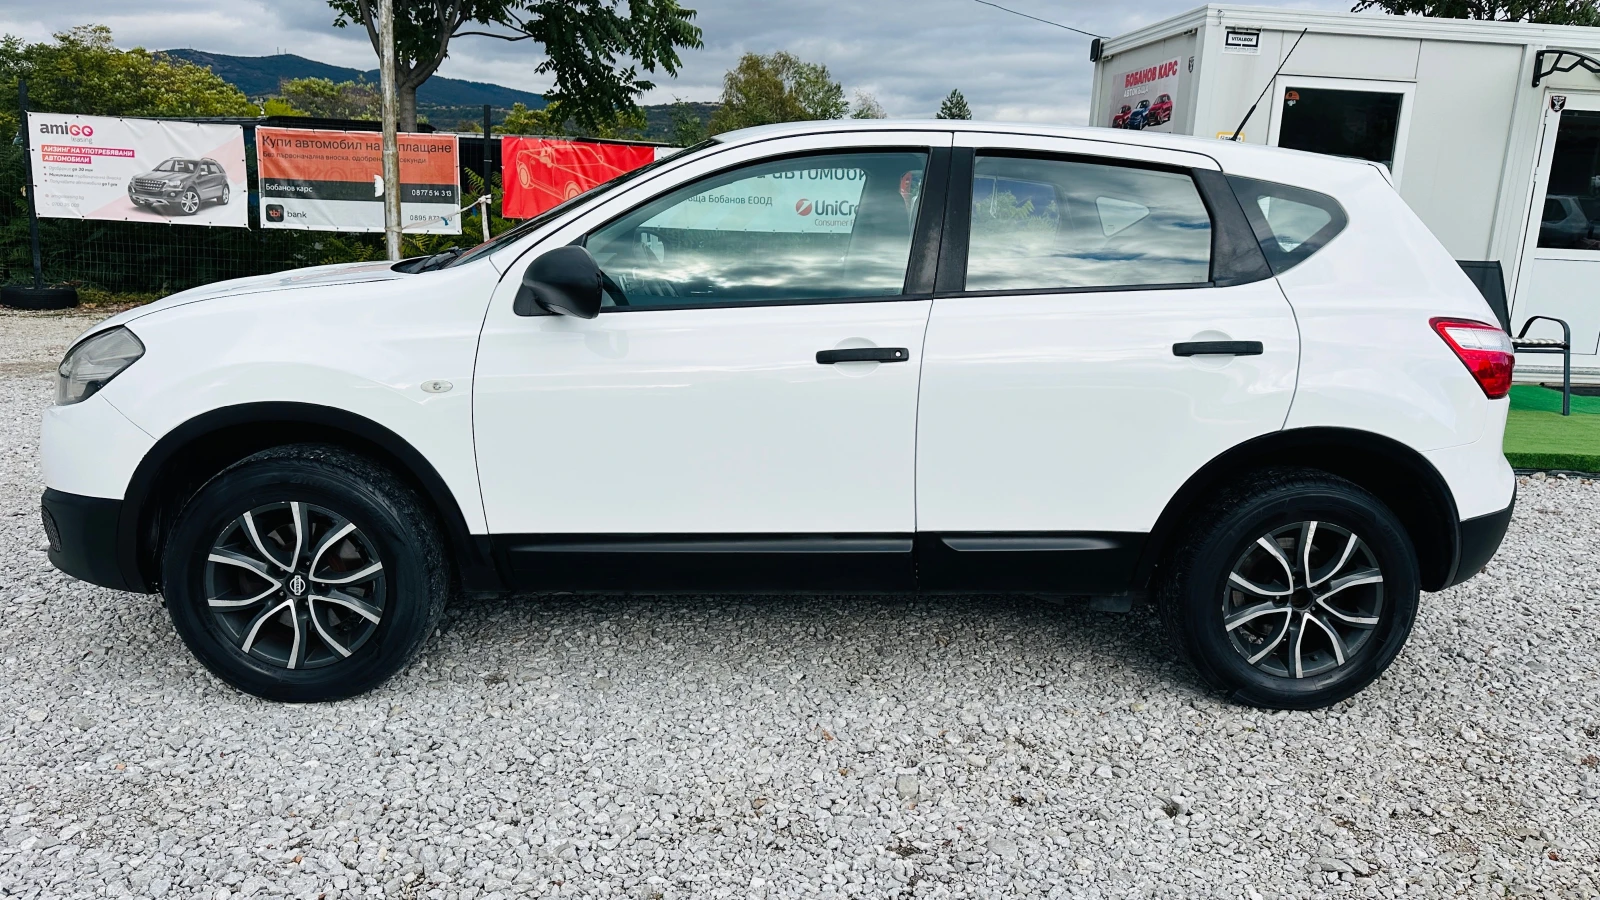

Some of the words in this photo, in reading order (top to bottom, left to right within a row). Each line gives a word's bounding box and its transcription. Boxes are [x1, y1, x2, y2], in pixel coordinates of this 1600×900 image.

[1124, 66, 1157, 88] БОБАНОВ
[1158, 60, 1178, 79] КАРС
[1123, 85, 1149, 97] АВТОКЪЩА
[71, 136, 93, 144] leasing
[261, 134, 292, 148] Купи
[295, 138, 362, 150] автомобил
[81, 148, 133, 157] УПОТРЕБЯВАНИ
[276, 153, 324, 161] първоначална
[44, 155, 90, 163] АВТОМОБИЛИ
[265, 183, 296, 192] Бобанов
[296, 186, 313, 194] карс
[411, 189, 427, 197] 0877
[708, 194, 746, 205] Бобанов
[748, 195, 773, 206] ЕООД
[269, 209, 281, 218] tbi
[286, 211, 308, 219] bank
[814, 218, 849, 227] Consumer
